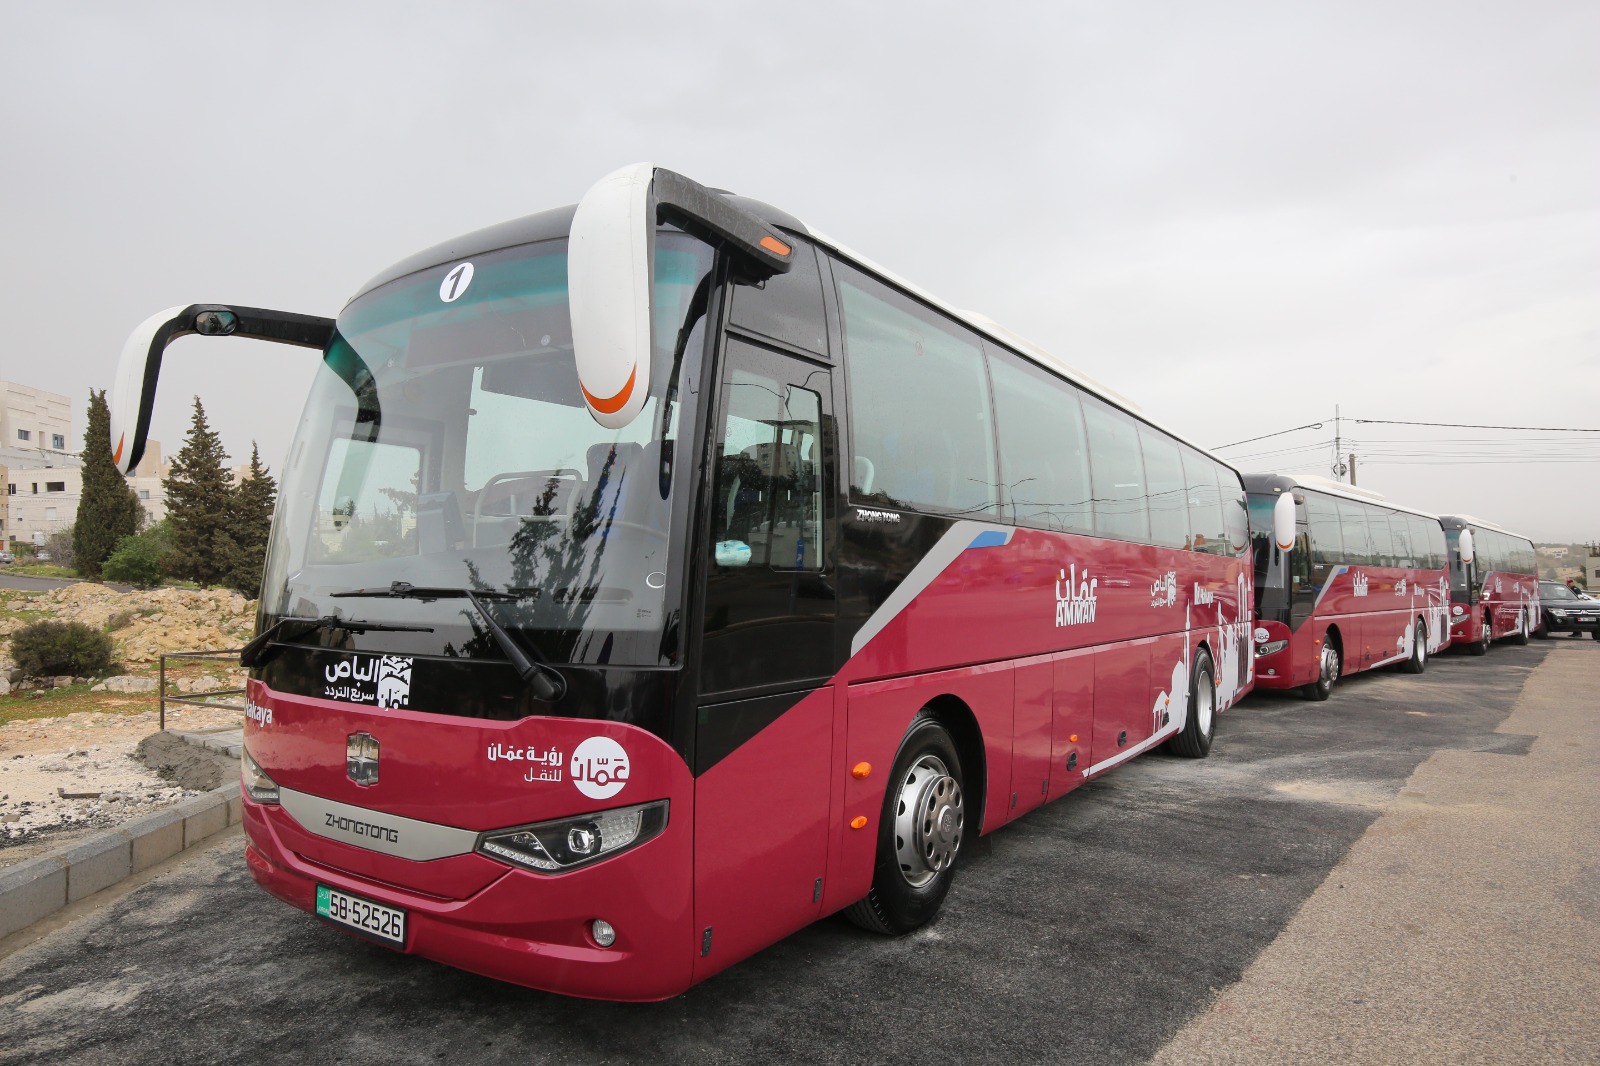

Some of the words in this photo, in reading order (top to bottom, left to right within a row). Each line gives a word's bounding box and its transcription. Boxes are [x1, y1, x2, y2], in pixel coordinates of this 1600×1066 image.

[449, 266, 466, 300] 1
[1055, 600, 1097, 628] AMMAN
[325, 655, 380, 688] الباص
[324, 685, 350, 700] التردد
[350, 687, 376, 703] سريع
[526, 746, 564, 767] رؤية
[523, 766, 563, 782] للنقل
[325, 812, 399, 843] ZHONGTONG
